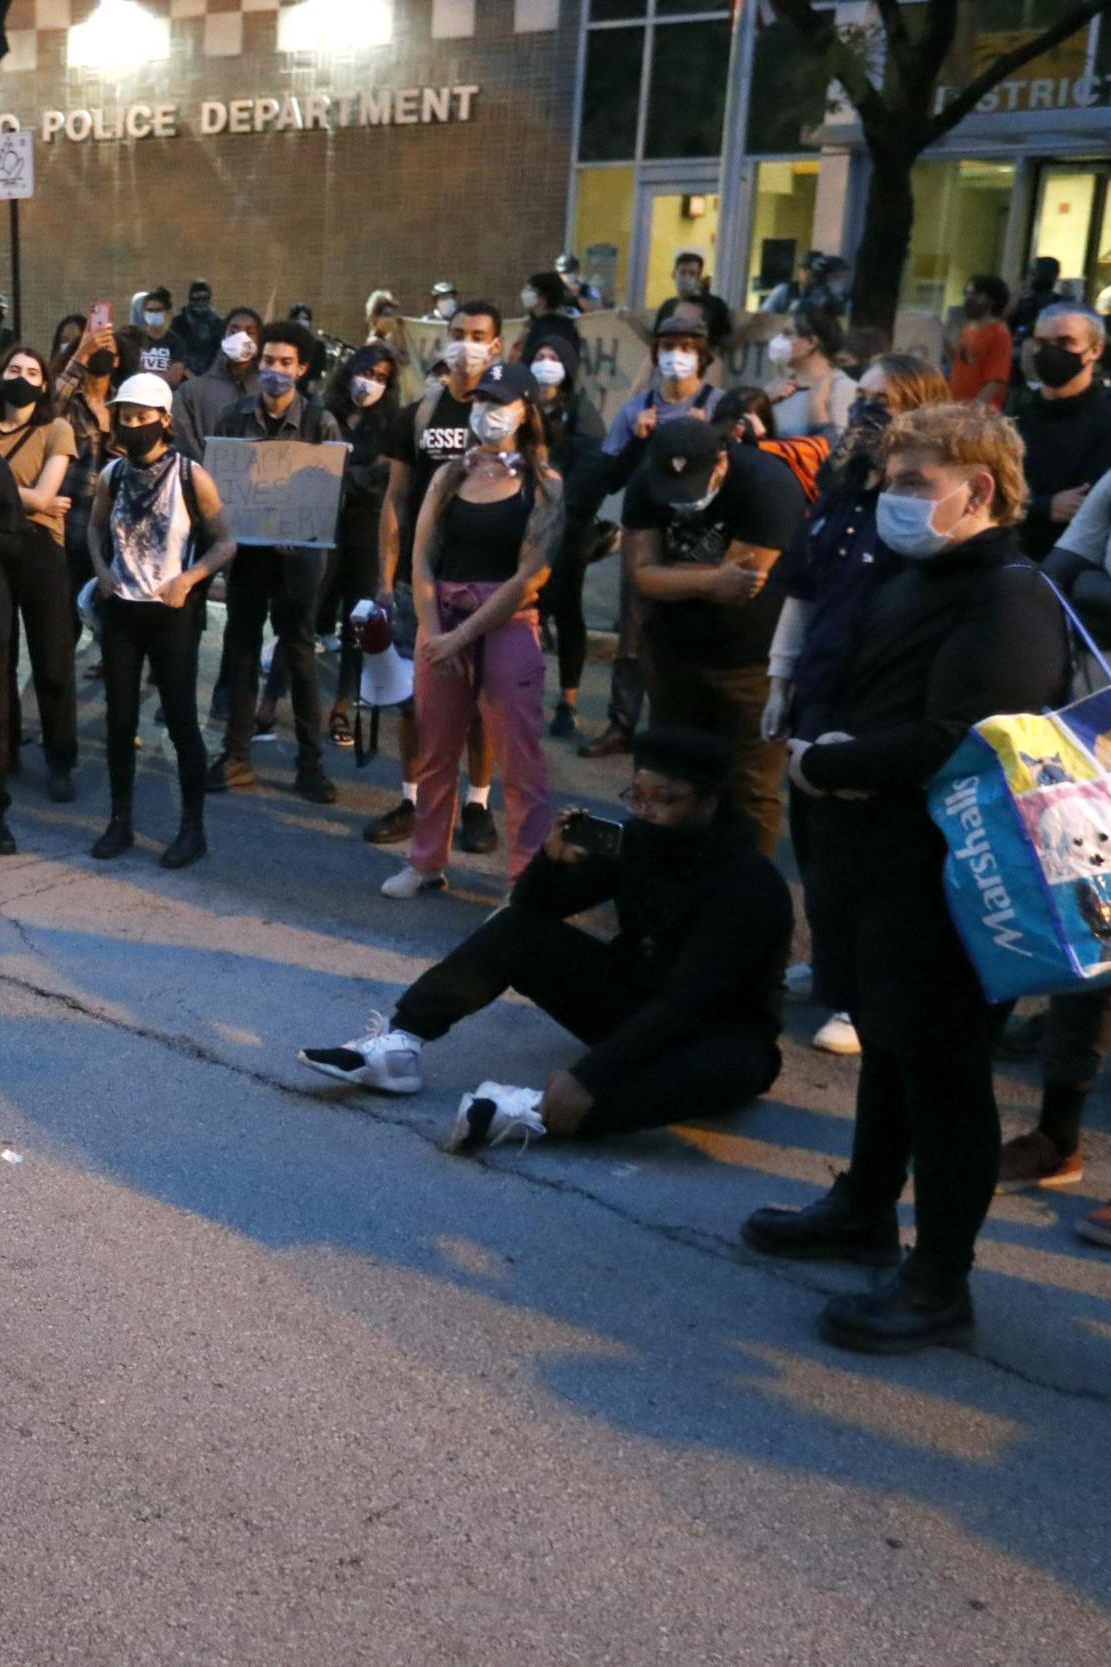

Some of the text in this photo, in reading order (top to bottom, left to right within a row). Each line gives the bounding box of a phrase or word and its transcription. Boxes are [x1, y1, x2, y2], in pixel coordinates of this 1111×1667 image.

[42, 101, 177, 143] POLICE
[200, 85, 480, 135] DEPARTMENT
[222, 477, 291, 505] IVES
[944, 775, 1033, 958] Marshalls
